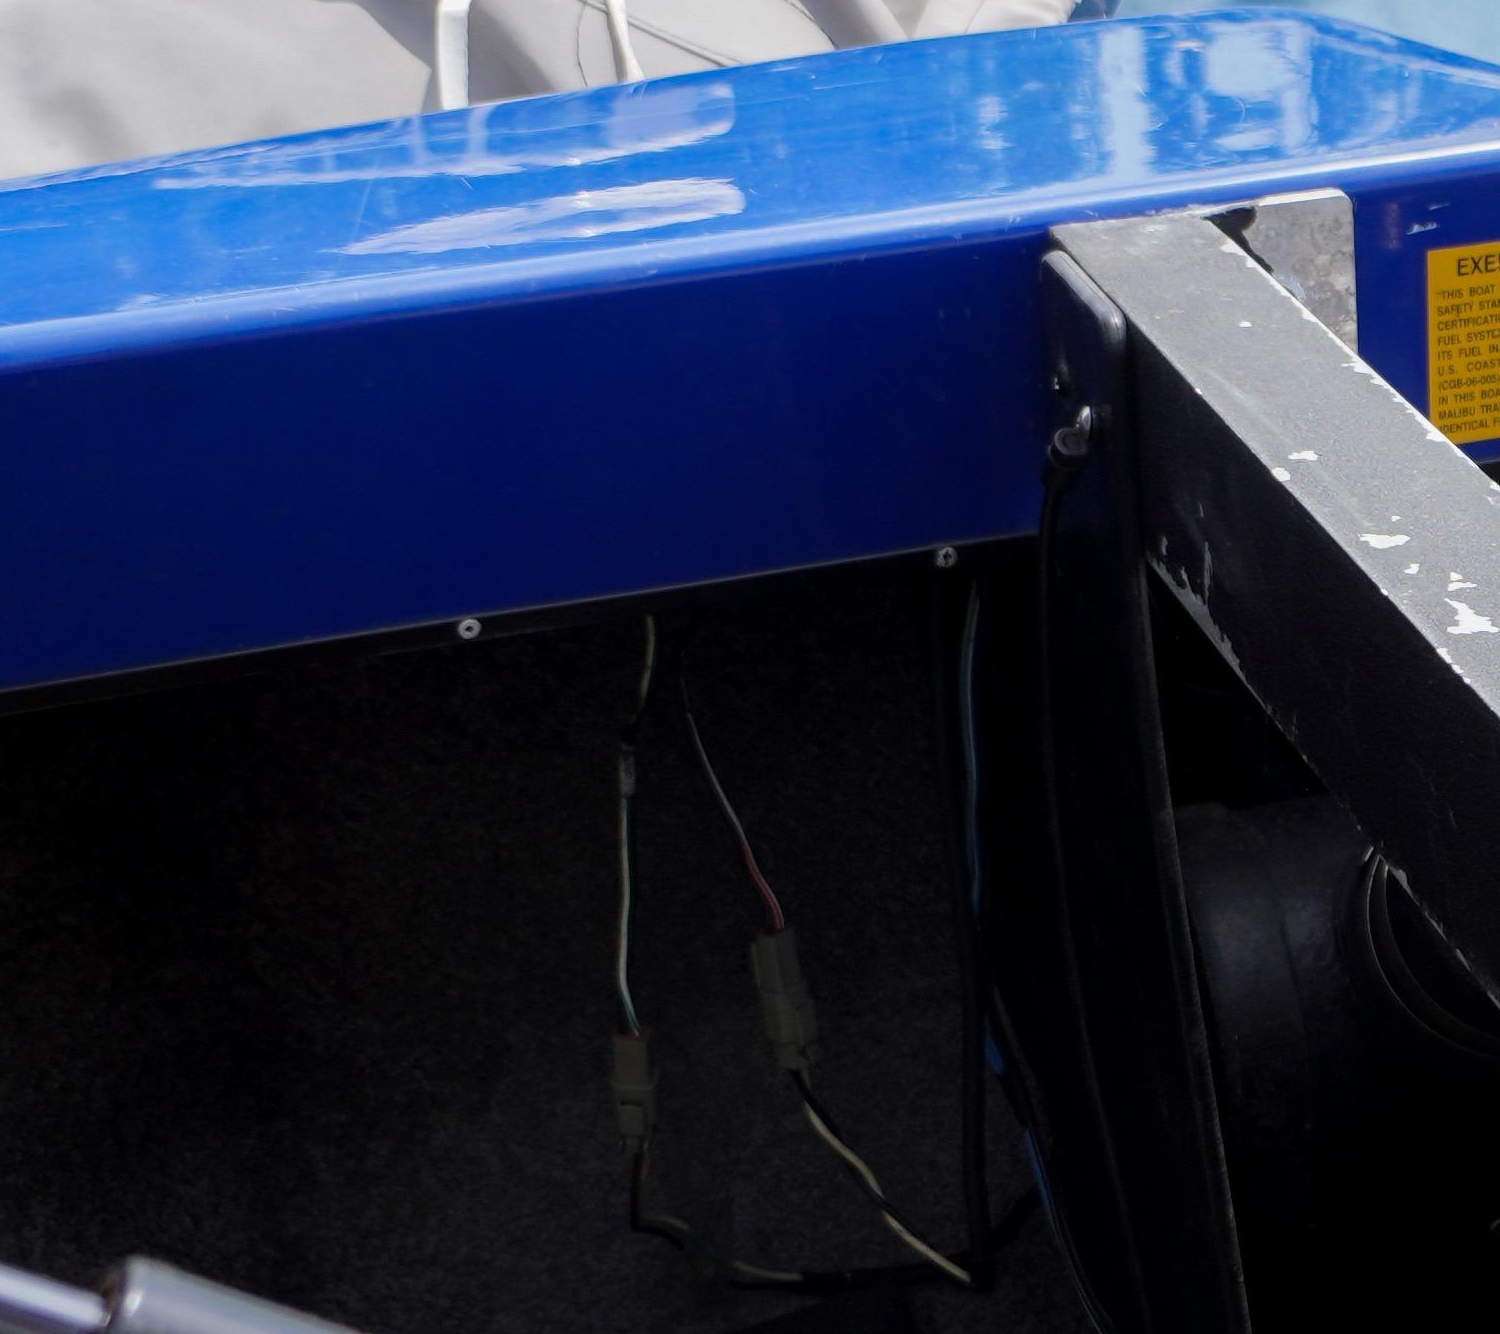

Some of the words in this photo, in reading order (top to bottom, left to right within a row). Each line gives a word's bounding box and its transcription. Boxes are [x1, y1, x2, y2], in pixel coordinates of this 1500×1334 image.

[1469, 284, 1495, 297] BOAT
[1437, 302, 1474, 316] SAFETY
[1437, 334, 1462, 347] FUEL
[1437, 350, 1453, 361] ITS
[1459, 346, 1483, 358] FUEL
[1467, 358, 1500, 373] COAST
[1438, 394, 1449, 406] IN
[1454, 392, 1476, 403] THIS
[1438, 407, 1476, 420] MALIBU
